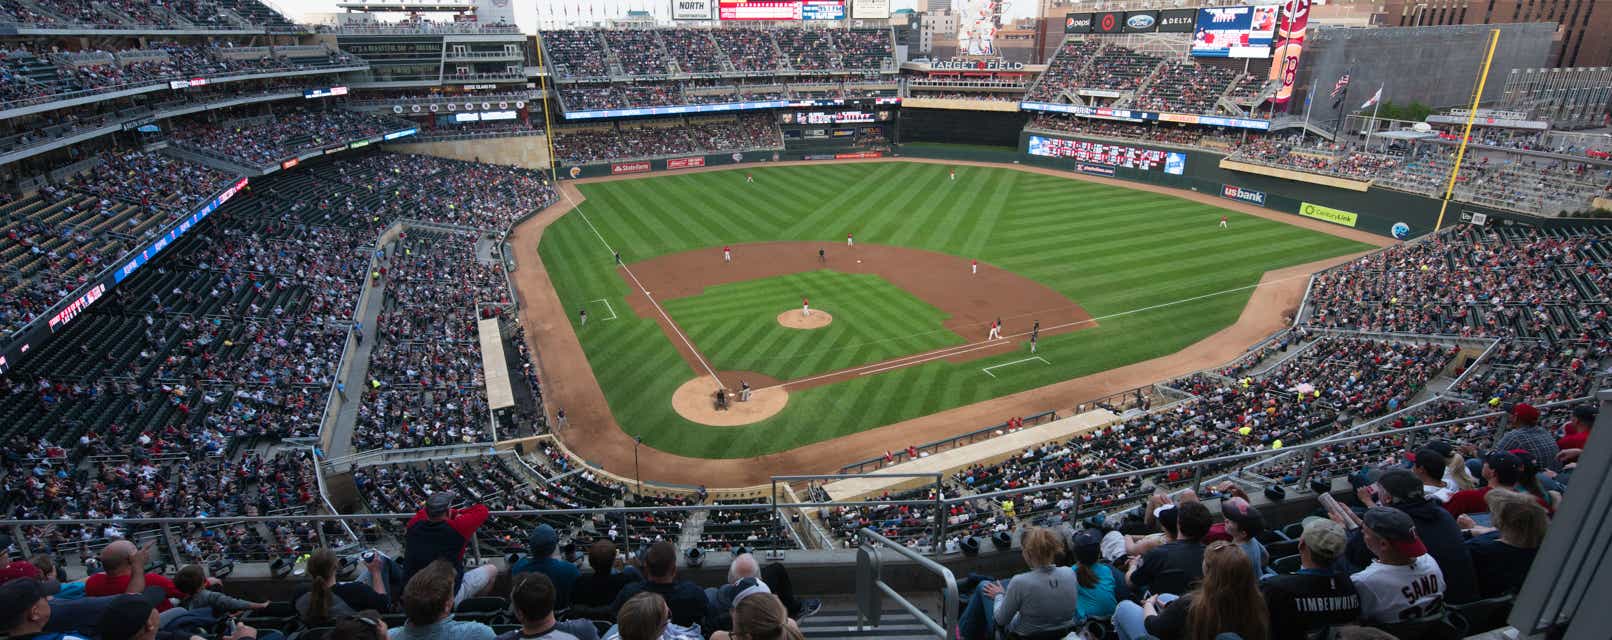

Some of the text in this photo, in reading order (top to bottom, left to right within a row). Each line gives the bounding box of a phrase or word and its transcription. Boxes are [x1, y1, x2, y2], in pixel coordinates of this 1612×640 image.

[679, 2, 705, 10] NORTH
[931, 61, 1024, 69] TARGET FIELD
